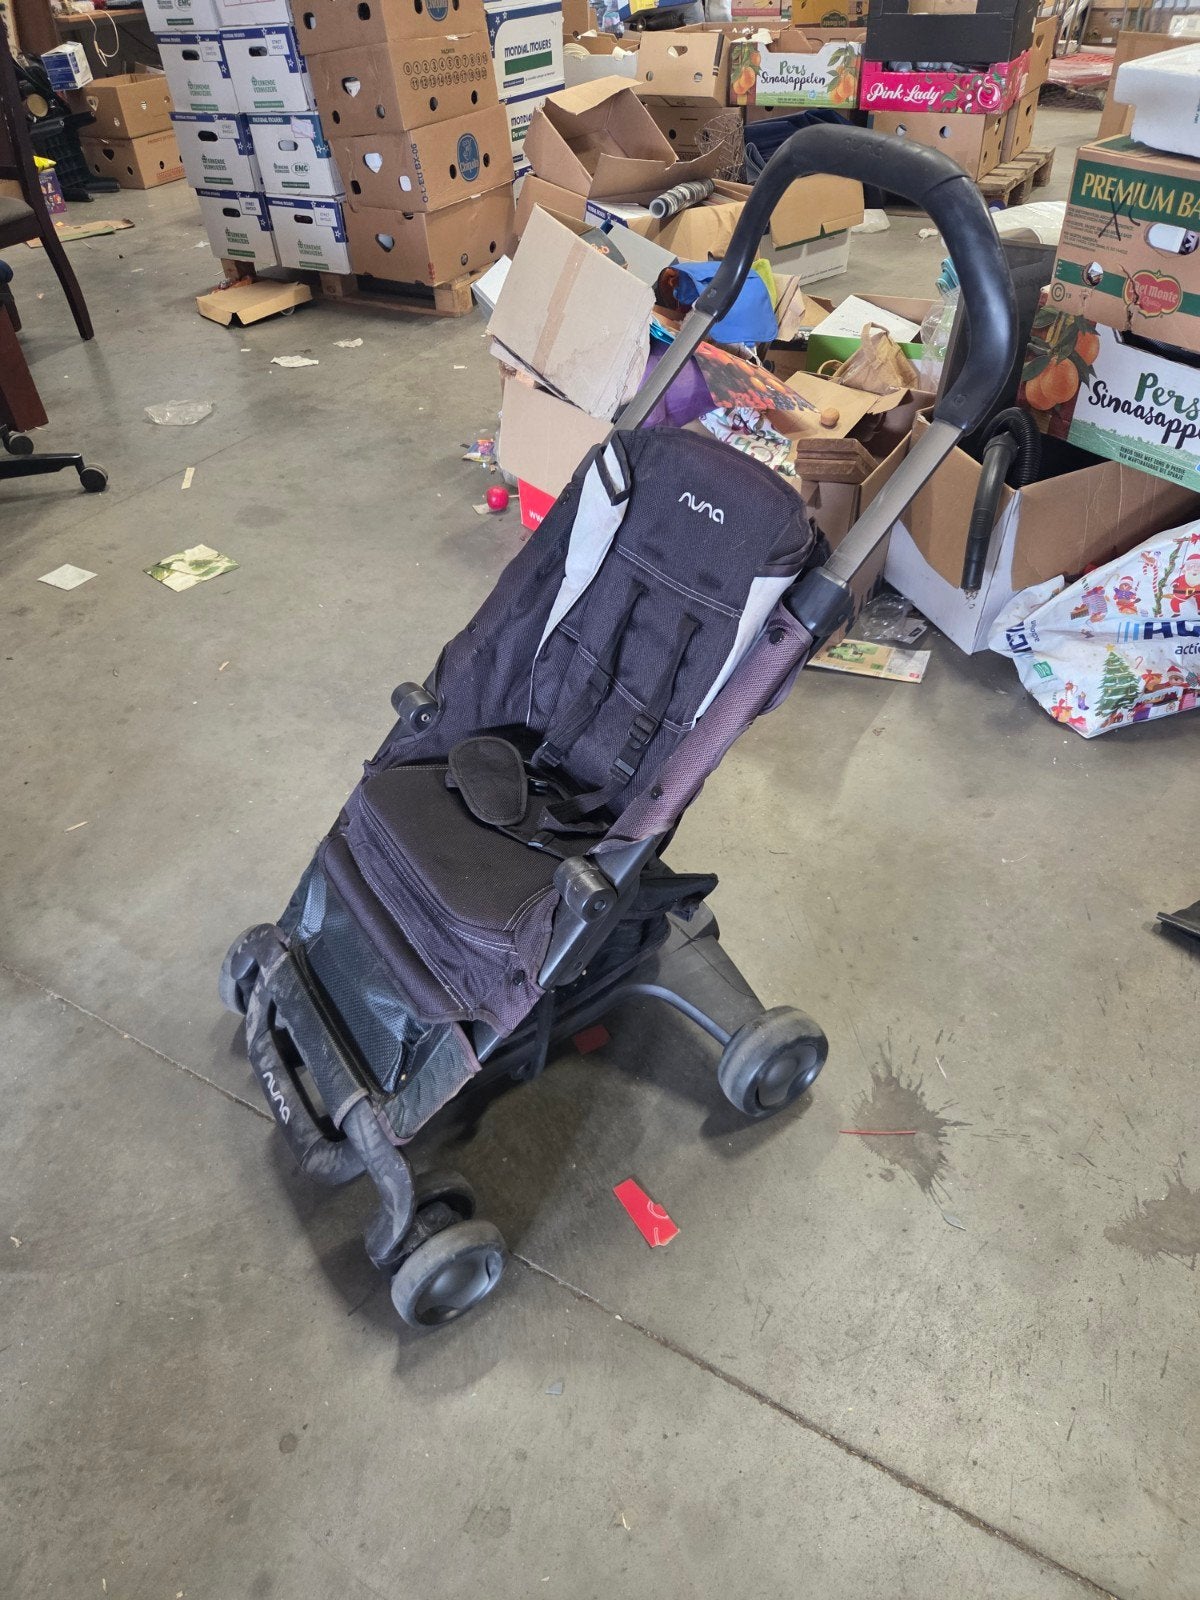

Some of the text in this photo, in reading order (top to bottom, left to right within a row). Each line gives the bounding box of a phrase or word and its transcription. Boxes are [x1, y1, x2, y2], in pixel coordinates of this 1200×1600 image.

[505, 39, 552, 58] MONDIAL MOVERS
[780, 60, 807, 76] Pers
[760, 71, 826, 91] Sinaasappelen
[866, 83, 941, 104] Pink Lady
[511, 113, 532, 126] MONDIA
[1081, 172, 1176, 214] PREMIUM
[1149, 285, 1179, 303] Monte
[1134, 372, 1200, 421] Pers
[1088, 380, 1200, 449] Sinaasapp
[678, 491, 725, 525] nuna
[1174, 642, 1200, 655] acti
[262, 1071, 290, 1124] nuna
